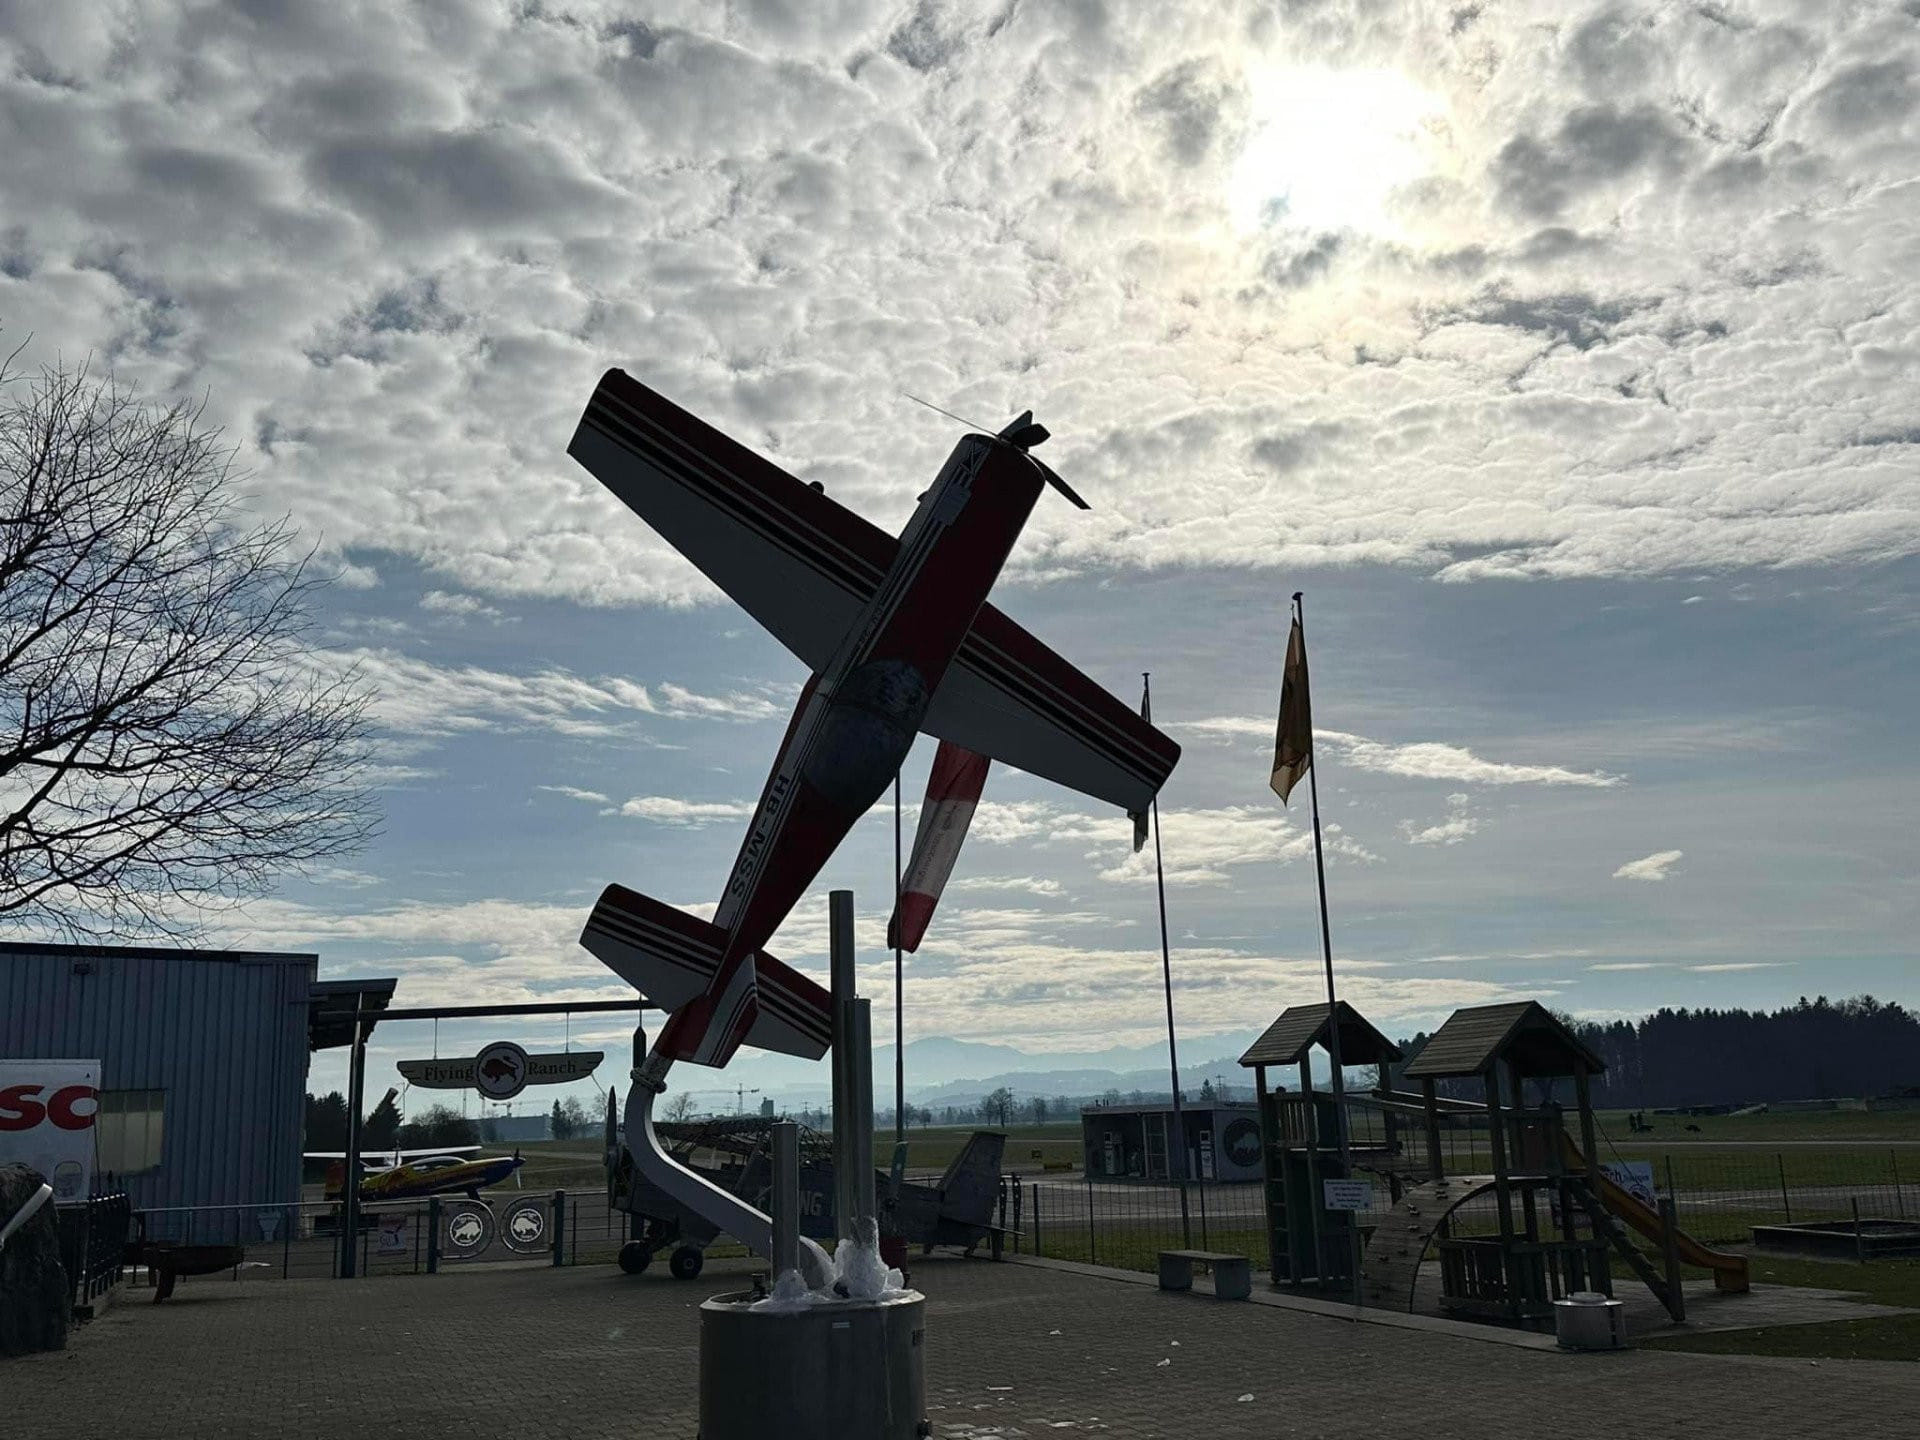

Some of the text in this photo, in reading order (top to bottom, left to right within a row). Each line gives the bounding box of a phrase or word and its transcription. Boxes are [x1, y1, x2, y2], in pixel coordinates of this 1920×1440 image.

[731, 774, 789, 898] HB-MSS
[424, 1061, 577, 1082] Flying Ranch
